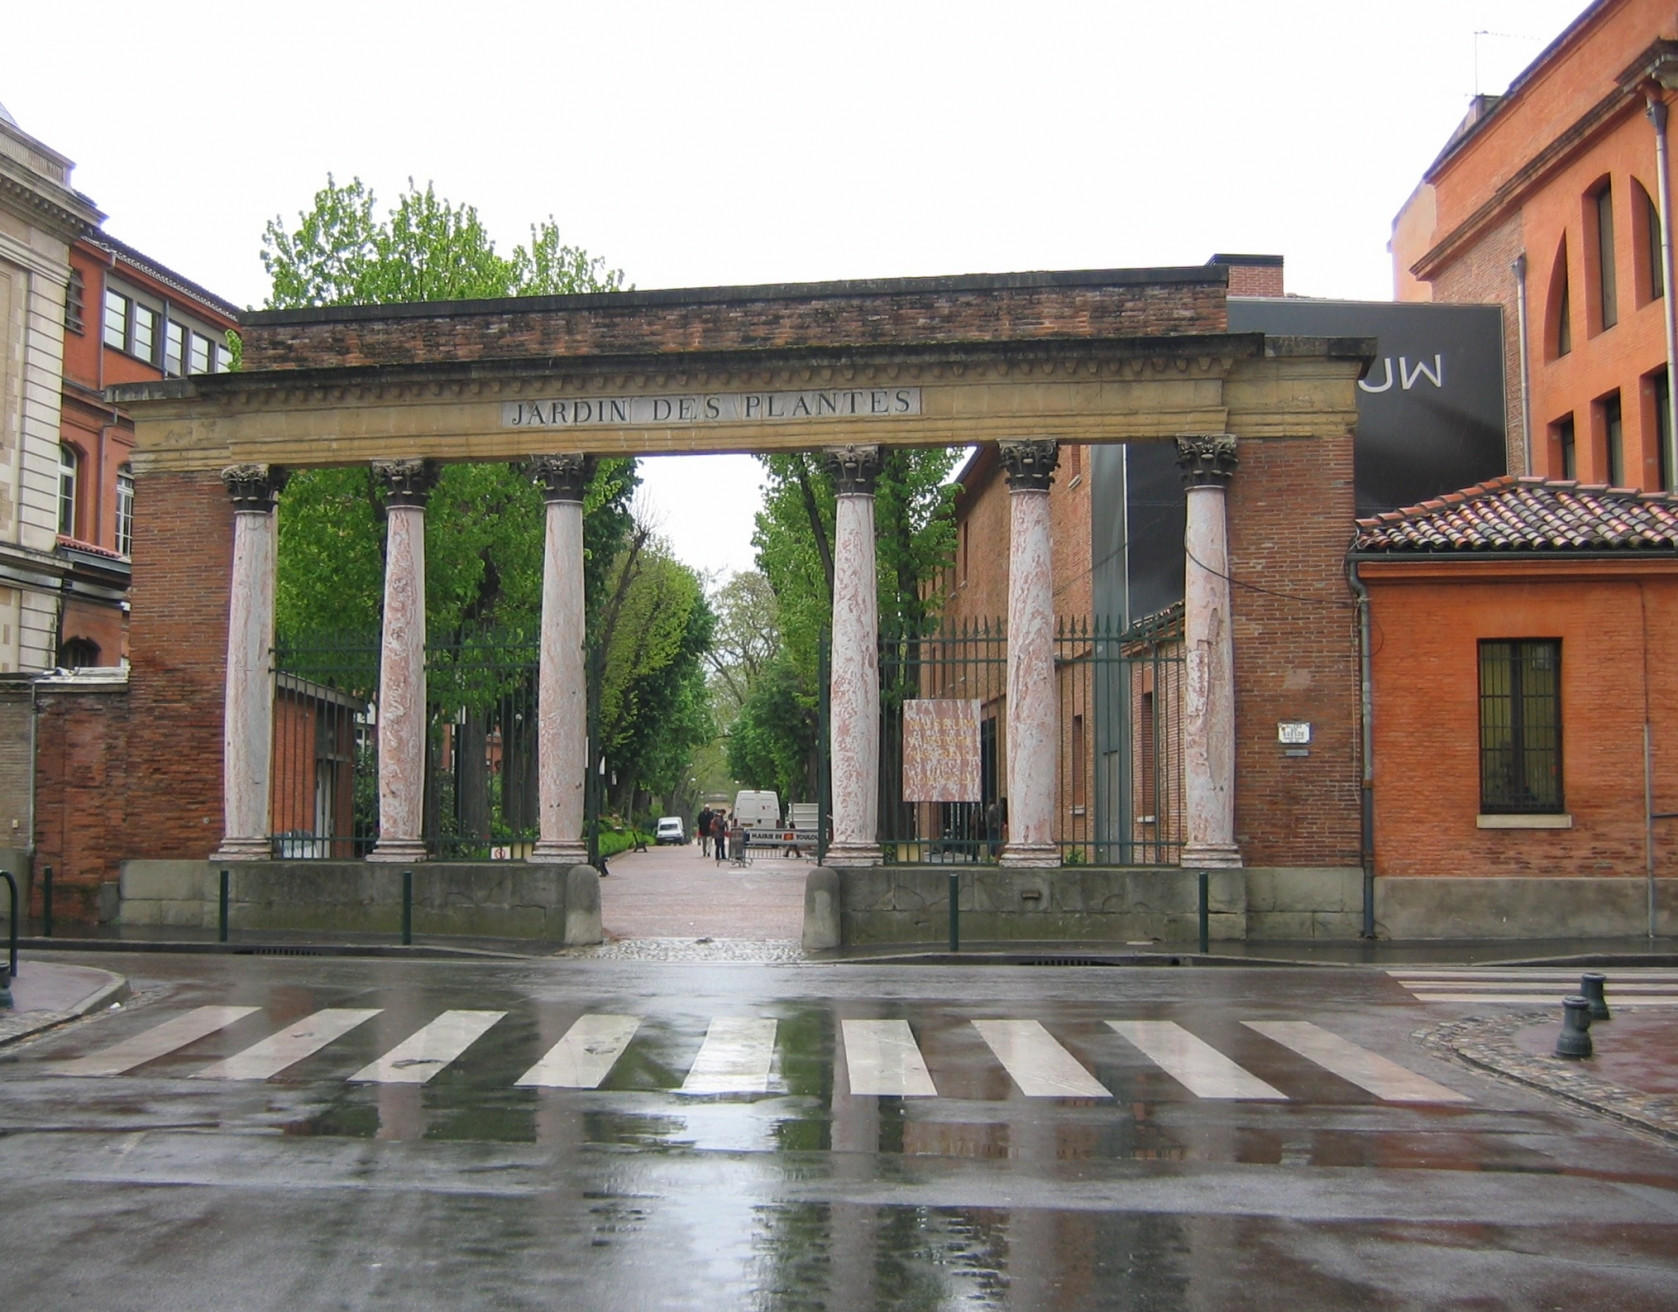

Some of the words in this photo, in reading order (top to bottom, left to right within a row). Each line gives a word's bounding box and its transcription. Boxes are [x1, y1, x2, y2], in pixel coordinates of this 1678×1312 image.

[511, 400, 627, 425] JARDIN
[652, 398, 720, 421] DES
[745, 389, 911, 418] PLANTES
[751, 832, 774, 840] MAIRIE
[796, 833, 819, 841] TOULOU
